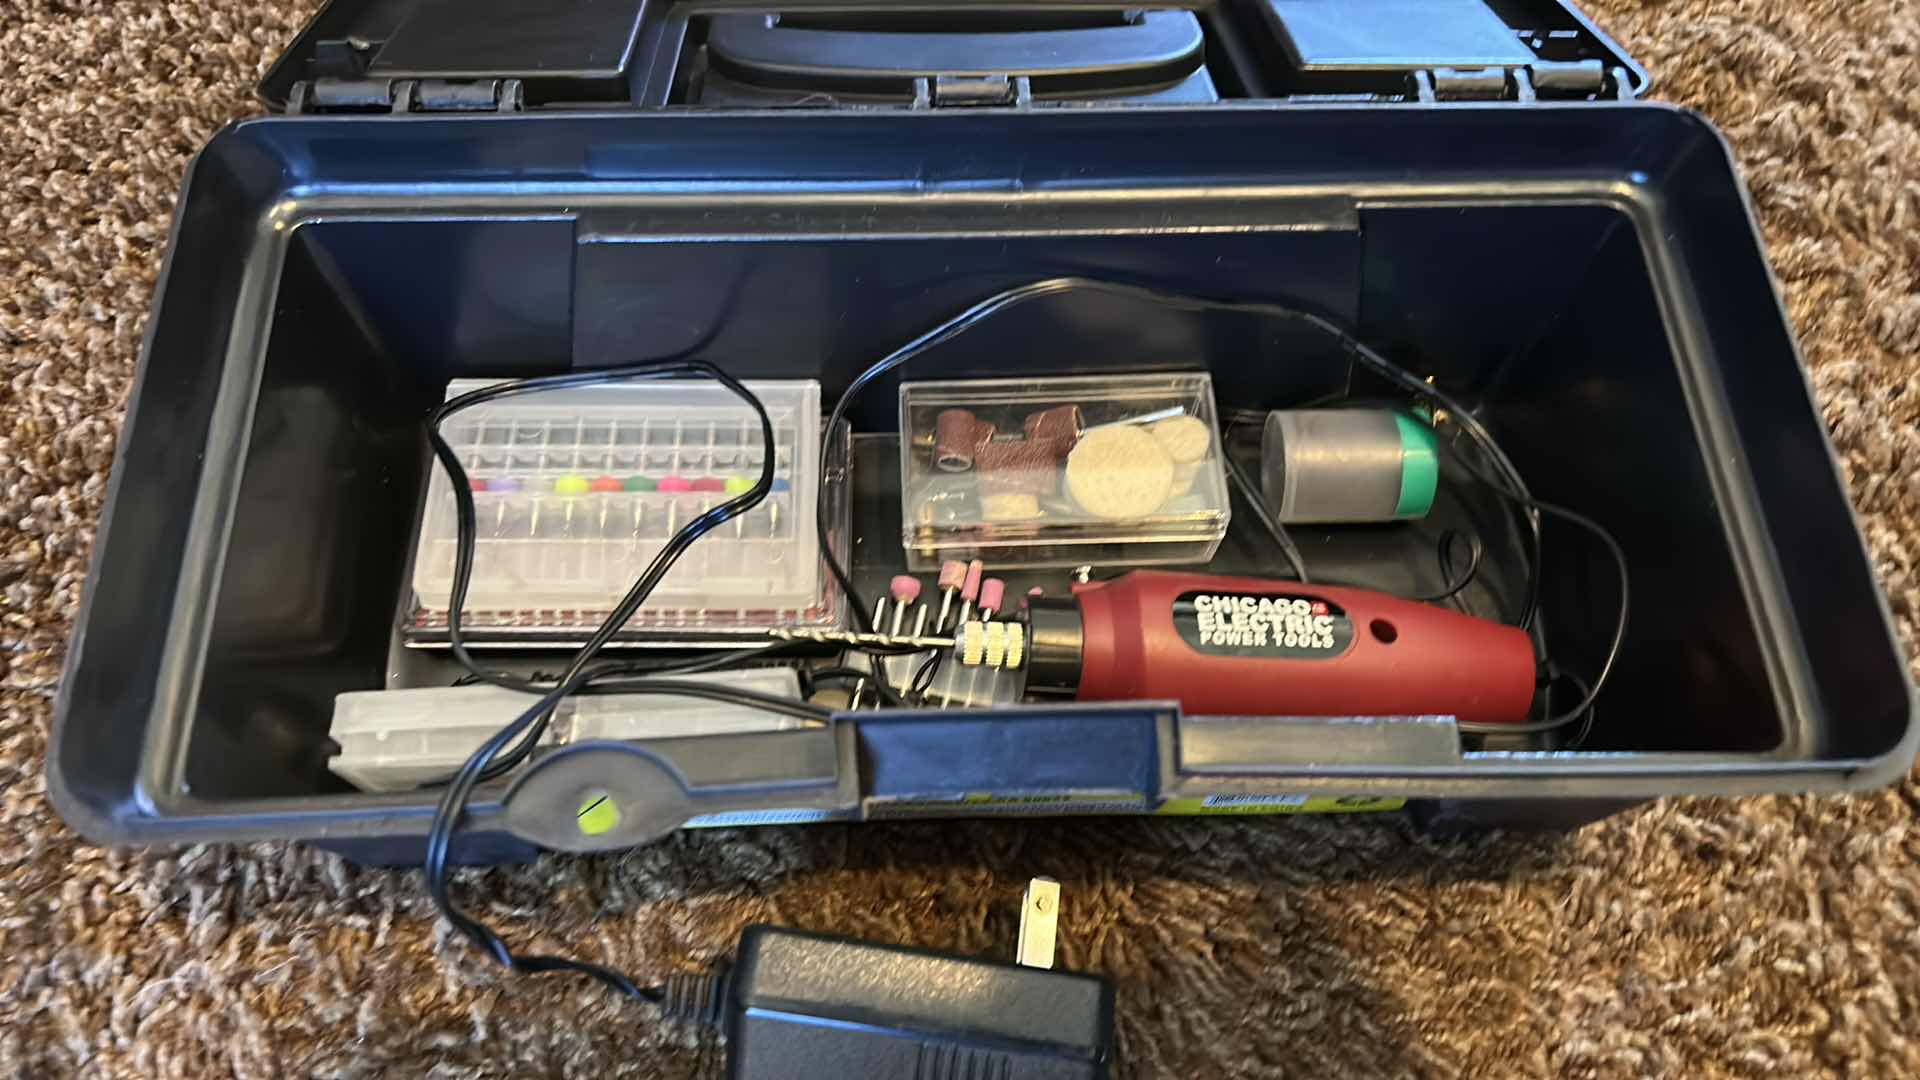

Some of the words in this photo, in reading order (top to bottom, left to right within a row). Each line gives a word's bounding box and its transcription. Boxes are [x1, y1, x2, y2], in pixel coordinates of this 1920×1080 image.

[1194, 595, 1312, 615] CHICAGO
[1197, 611, 1335, 635] ELECTRIC
[1200, 630, 1267, 646] POWER
[1273, 632, 1335, 648] TOOLS
